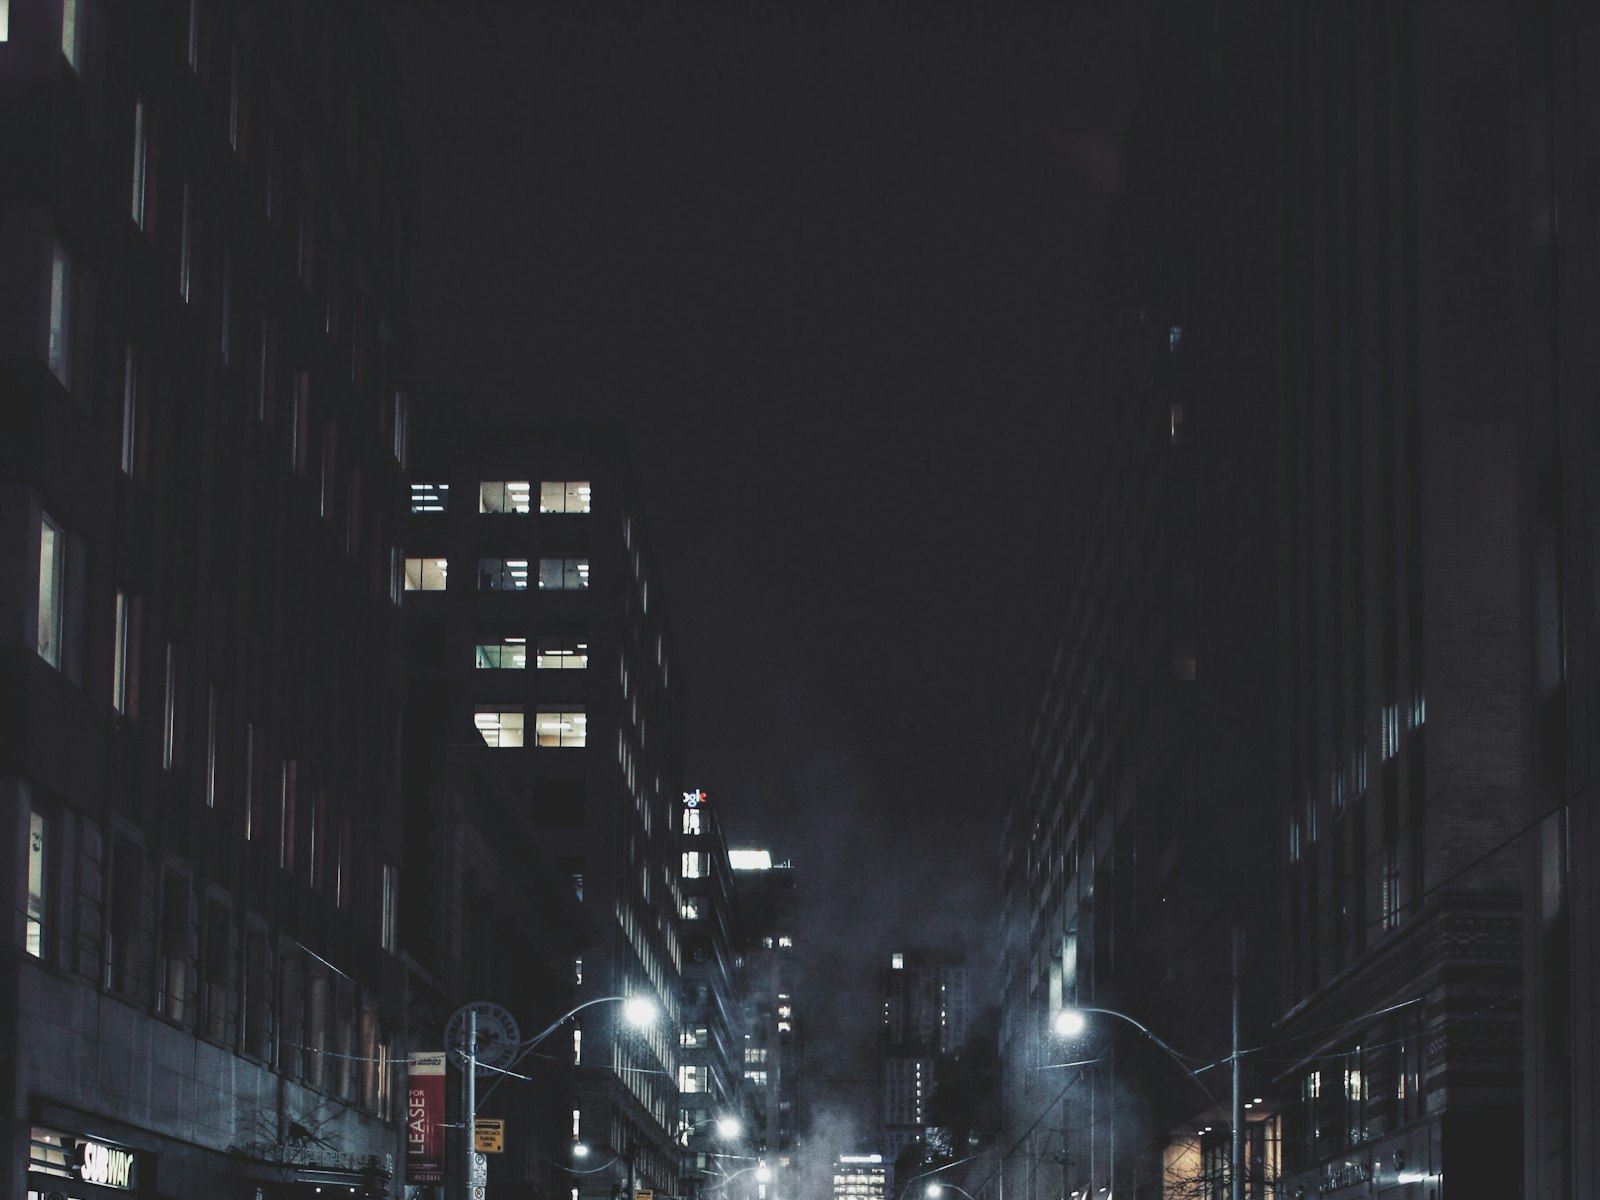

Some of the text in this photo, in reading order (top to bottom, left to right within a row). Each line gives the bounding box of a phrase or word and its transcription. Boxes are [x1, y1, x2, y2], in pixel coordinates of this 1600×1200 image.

[408, 1089, 425, 1097] FOR
[408, 1097, 425, 1155] LEASE
[80, 1141, 134, 1187] SUBWAY
